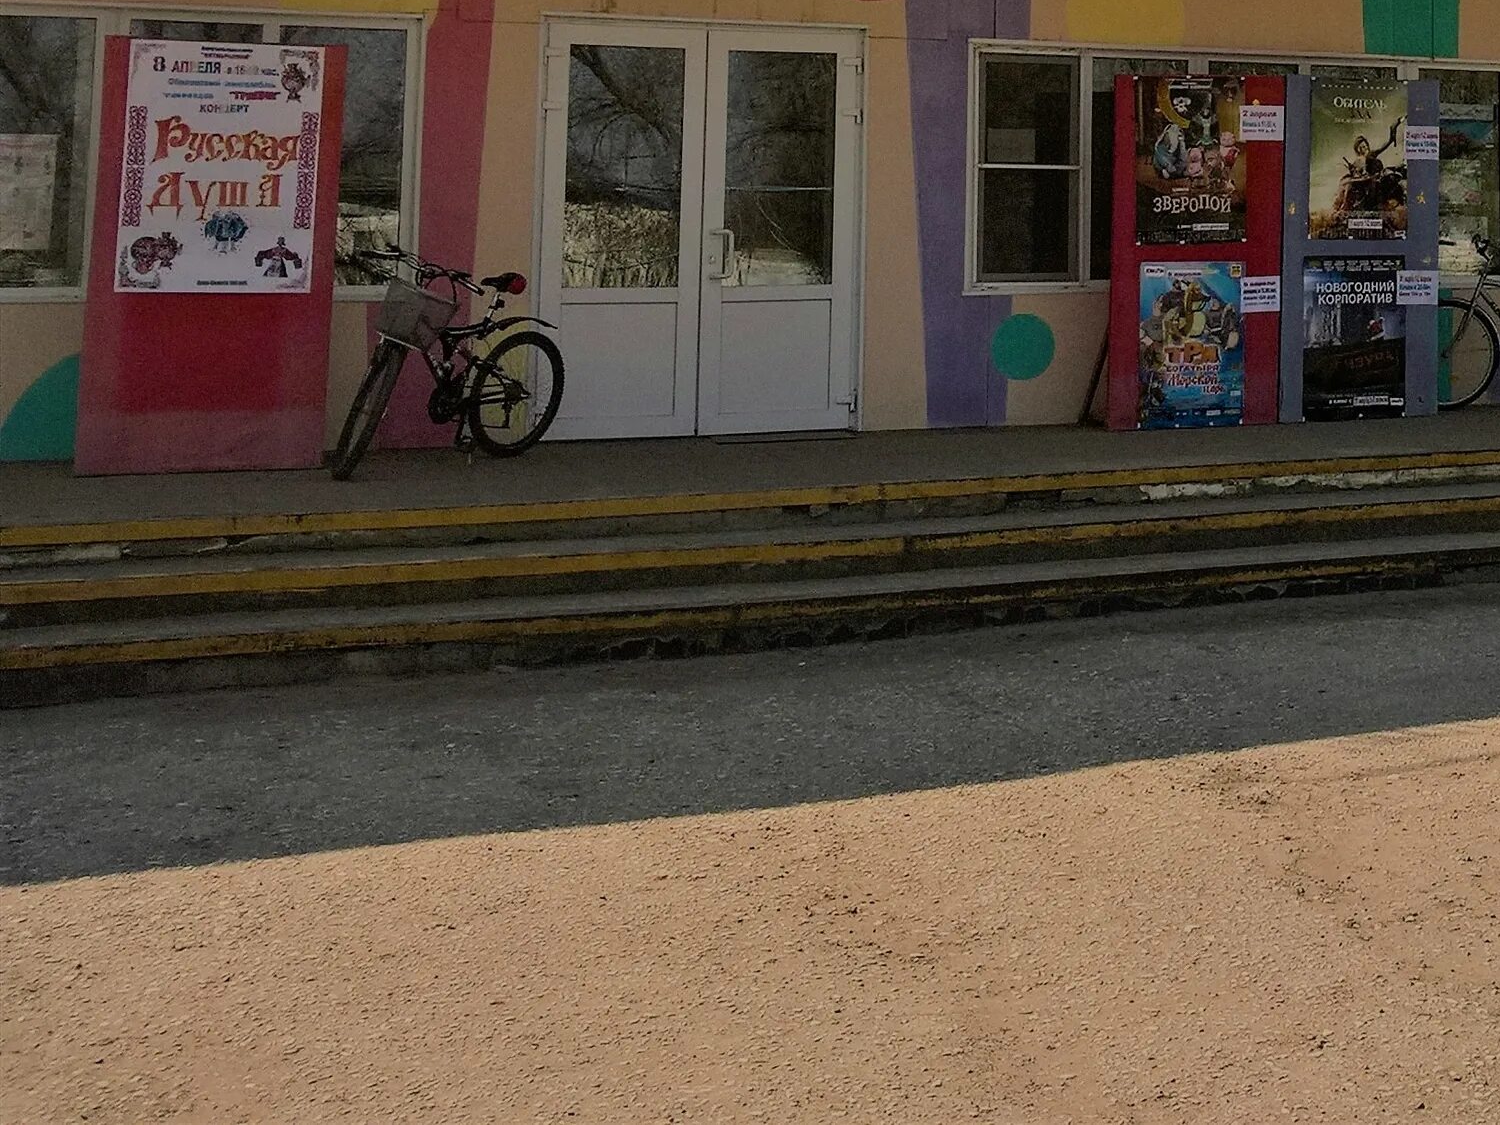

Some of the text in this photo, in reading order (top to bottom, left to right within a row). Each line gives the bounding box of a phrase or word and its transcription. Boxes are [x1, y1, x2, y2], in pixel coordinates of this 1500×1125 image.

[153, 56, 166, 72] 8
[151, 115, 300, 171] Русская
[1153, 194, 1232, 214] ЗВЕРОПОЙ
[1316, 280, 1395, 293] НОВОГОДНИЙ
[1318, 293, 1393, 305] КОРПОРАТИВ
